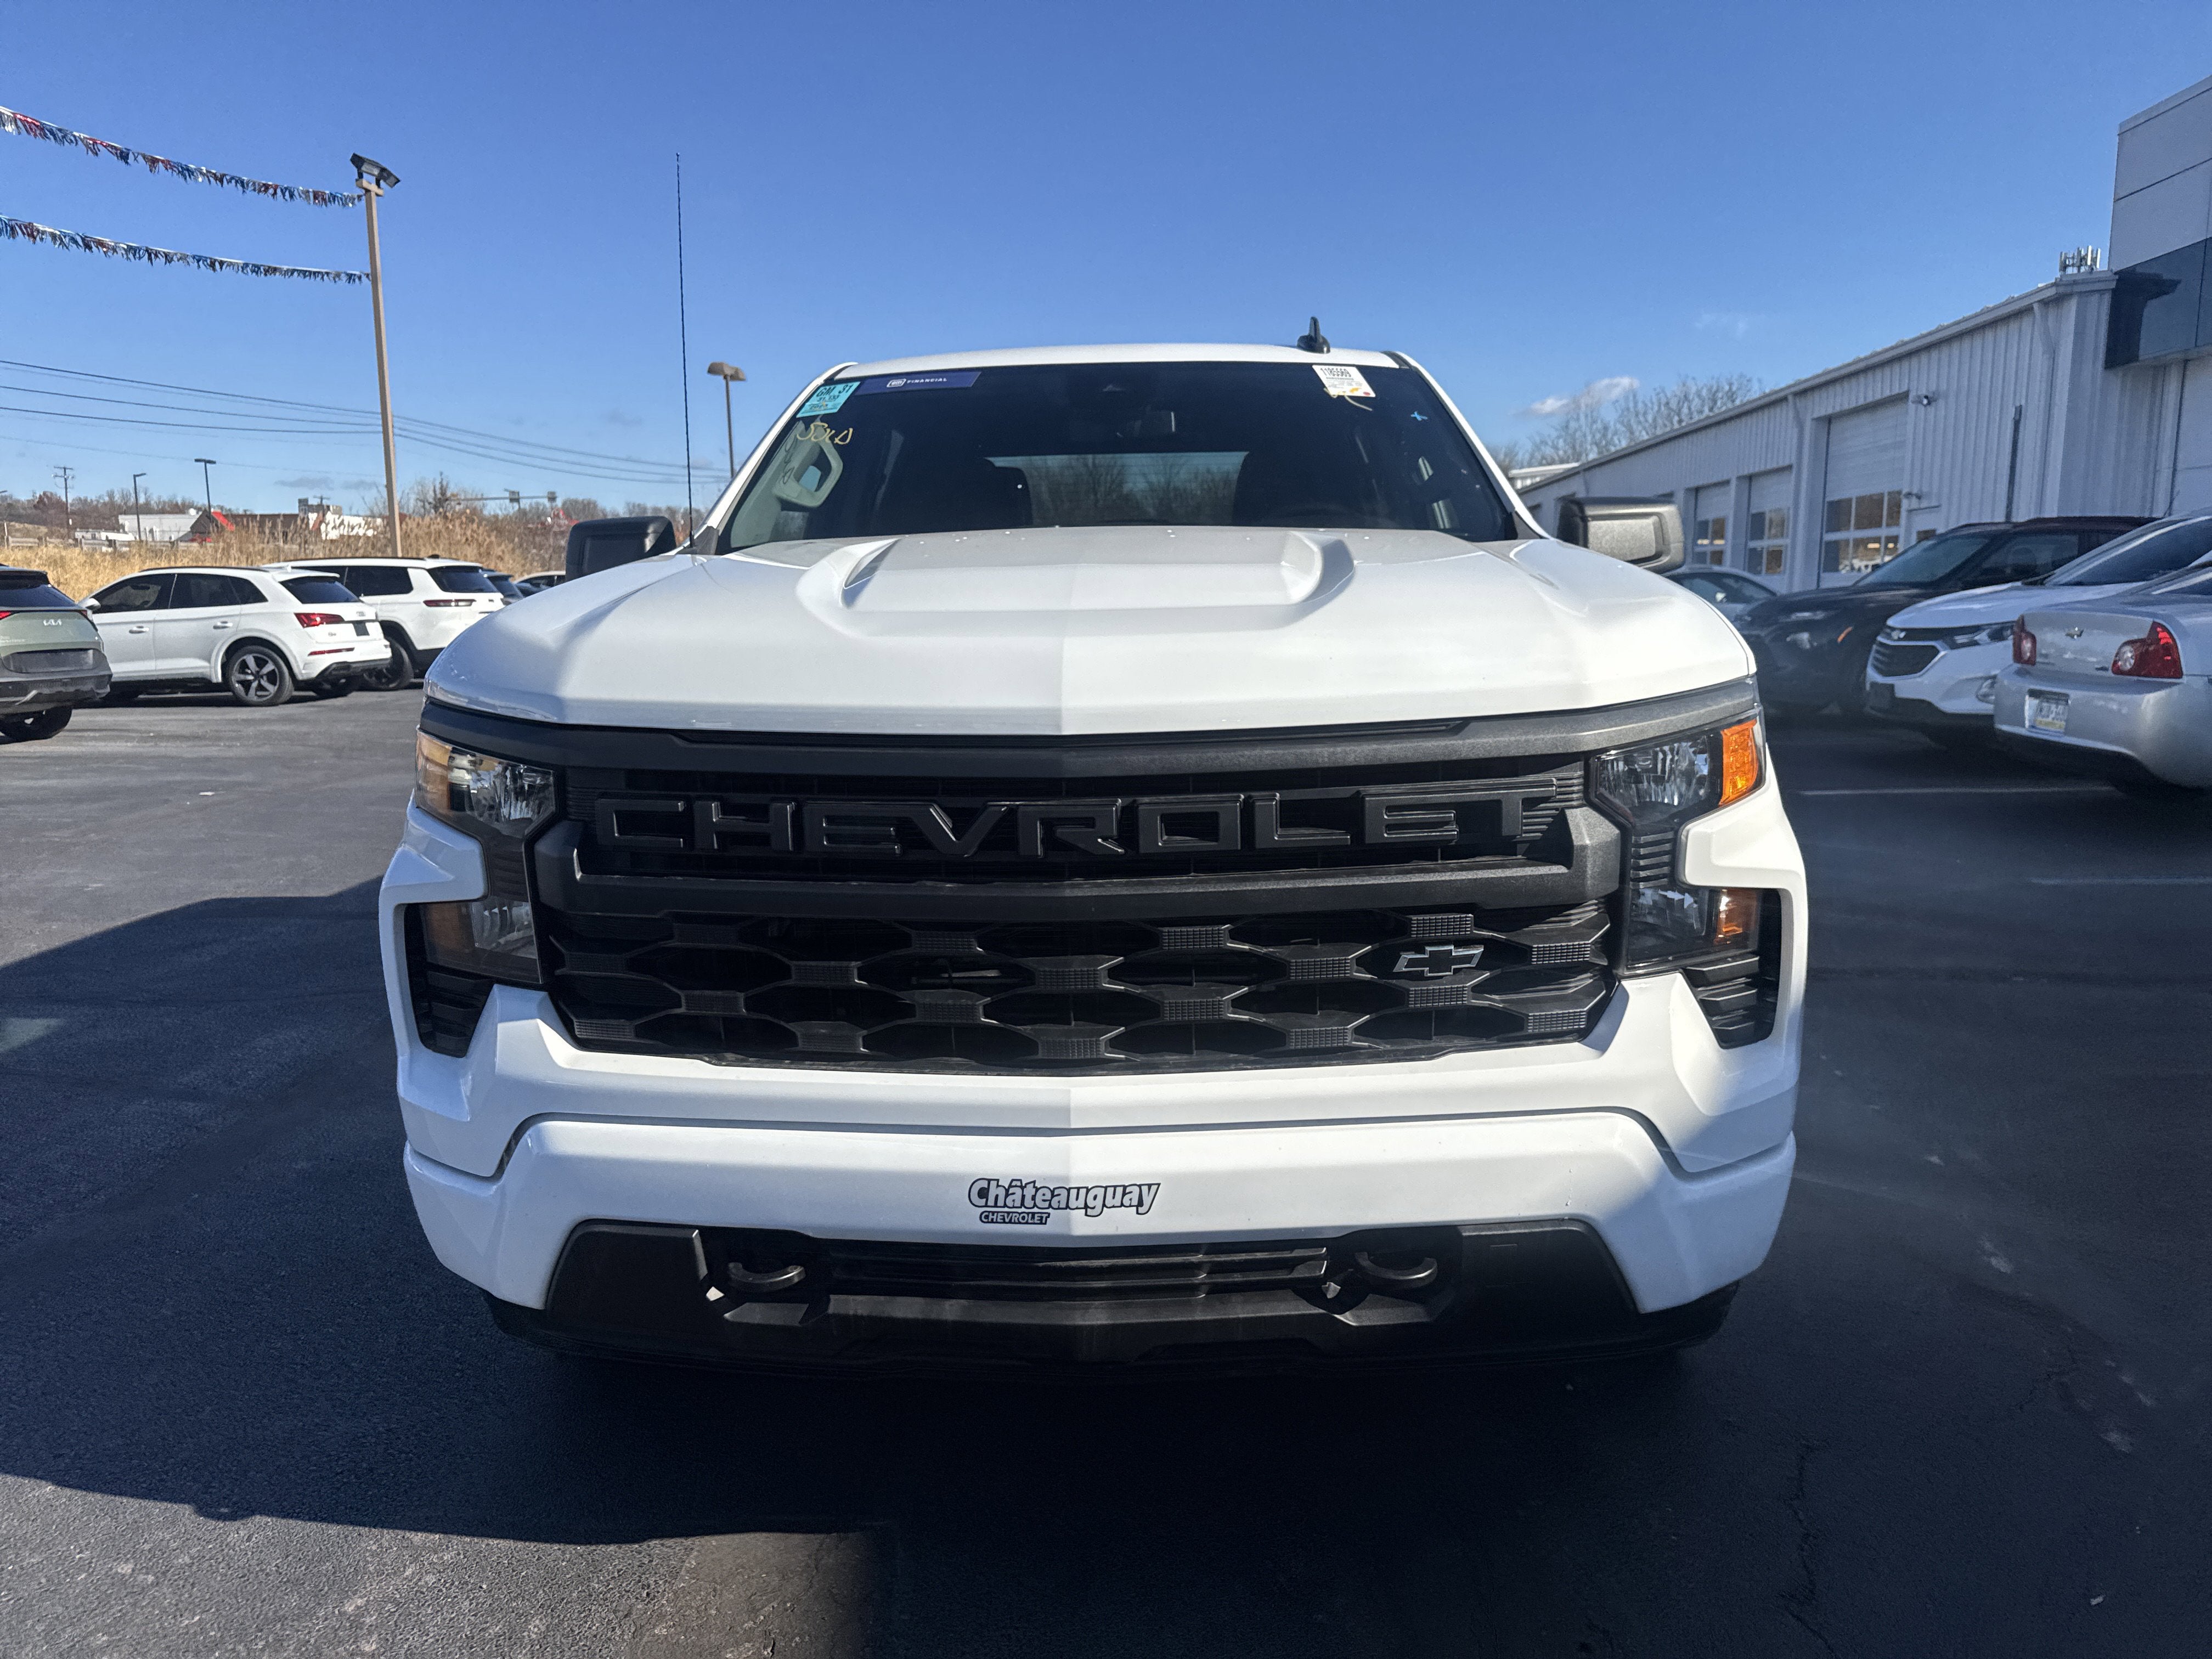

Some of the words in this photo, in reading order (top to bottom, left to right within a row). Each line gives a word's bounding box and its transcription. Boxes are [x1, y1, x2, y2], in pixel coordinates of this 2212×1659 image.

[816, 386, 836, 397] GM
[596, 781, 1557, 857] CHEVROLET
[968, 1178, 1160, 1217] Châteauguay
[980, 1211, 1049, 1224] CHEVROLET
